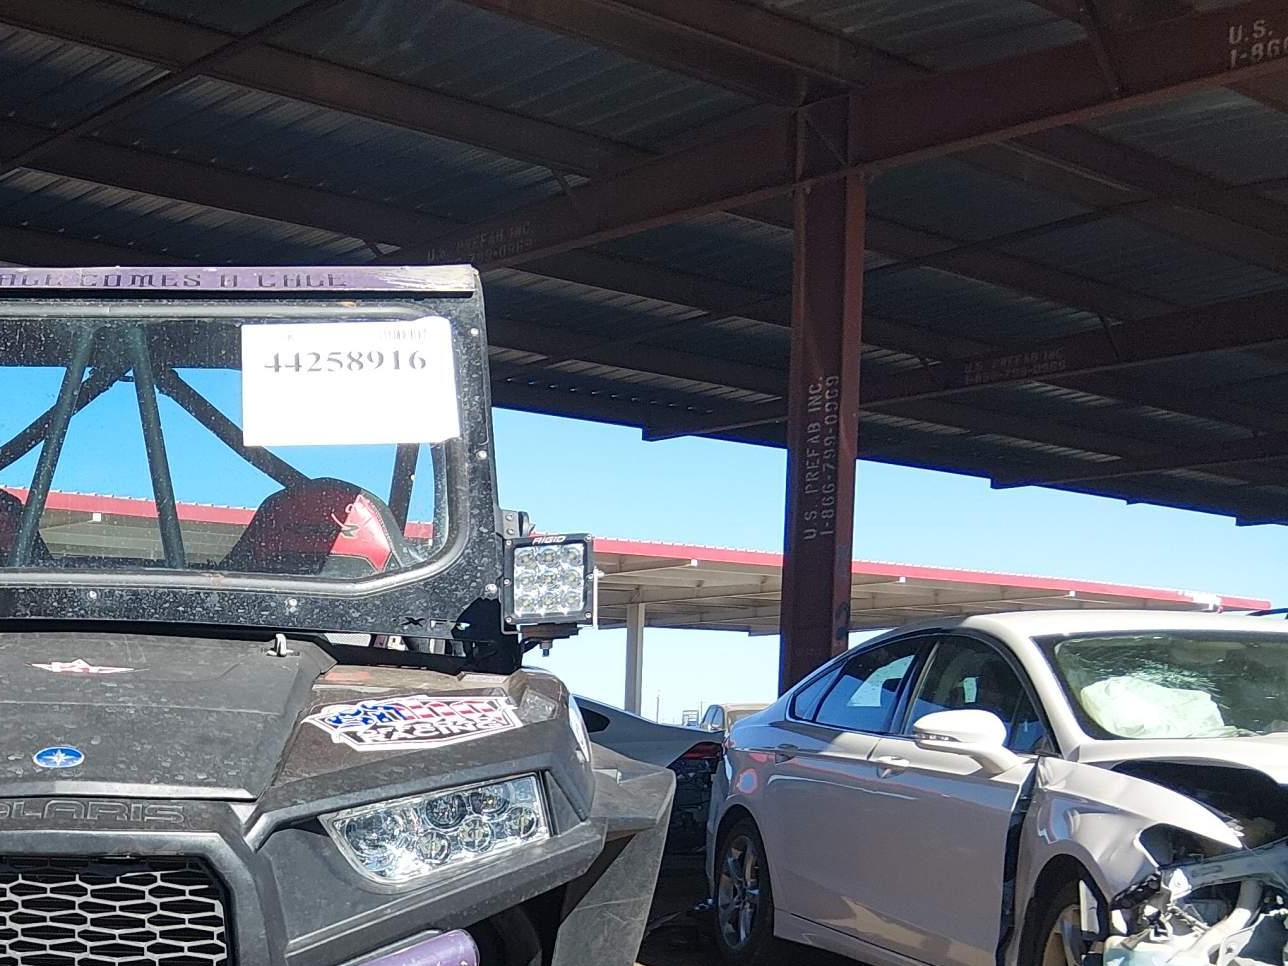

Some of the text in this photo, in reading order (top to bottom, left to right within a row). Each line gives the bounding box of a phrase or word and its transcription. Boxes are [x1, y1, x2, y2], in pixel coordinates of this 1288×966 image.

[1229, 20, 1273, 45] U.S.
[79, 274, 200, 287] COMES
[264, 350, 426, 372] 44258916
[803, 375, 824, 540] U.S. PREFAB INC.
[532, 536, 567, 545] RIGID
